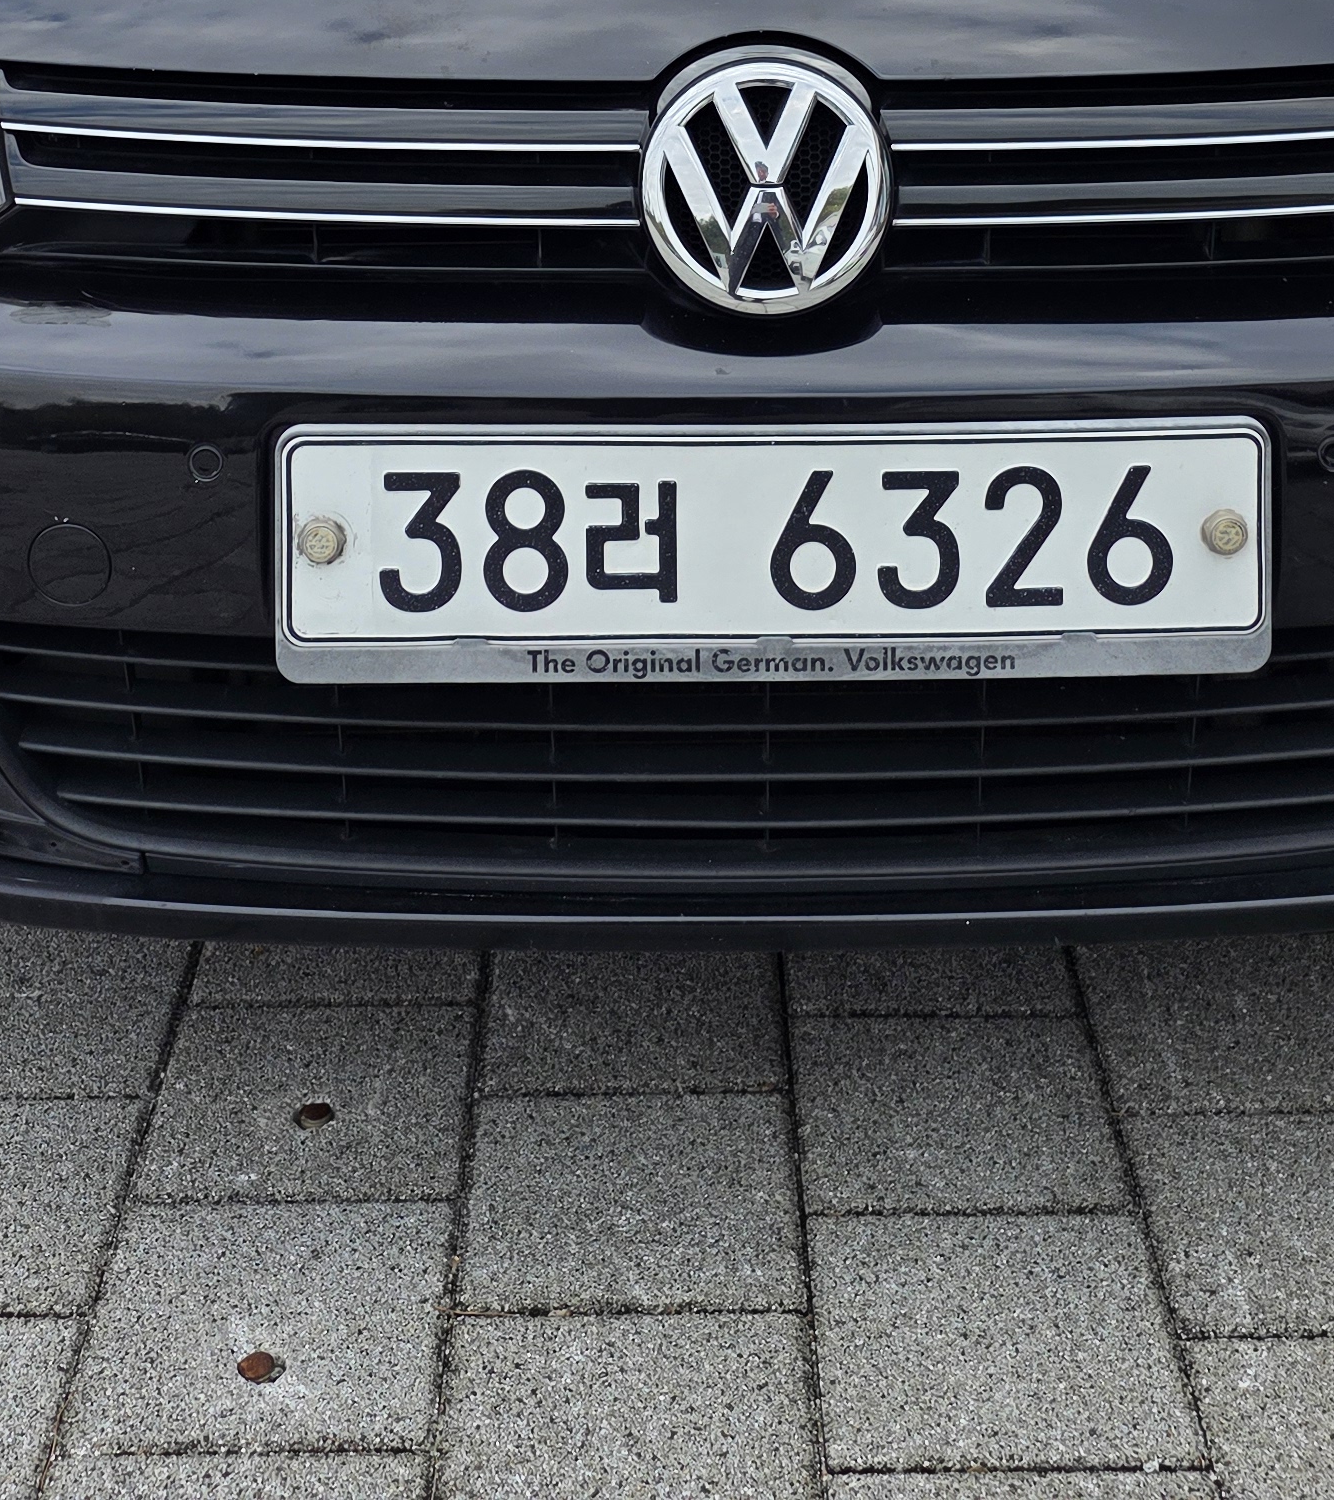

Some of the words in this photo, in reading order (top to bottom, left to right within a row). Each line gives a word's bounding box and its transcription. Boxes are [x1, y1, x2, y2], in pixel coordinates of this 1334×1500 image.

[380, 469, 678, 614] 38러
[770, 464, 1175, 612] 6326
[527, 649, 576, 674] The
[585, 648, 702, 680] Original
[711, 650, 834, 674] German.
[843, 647, 1016, 676] Volkswagen
